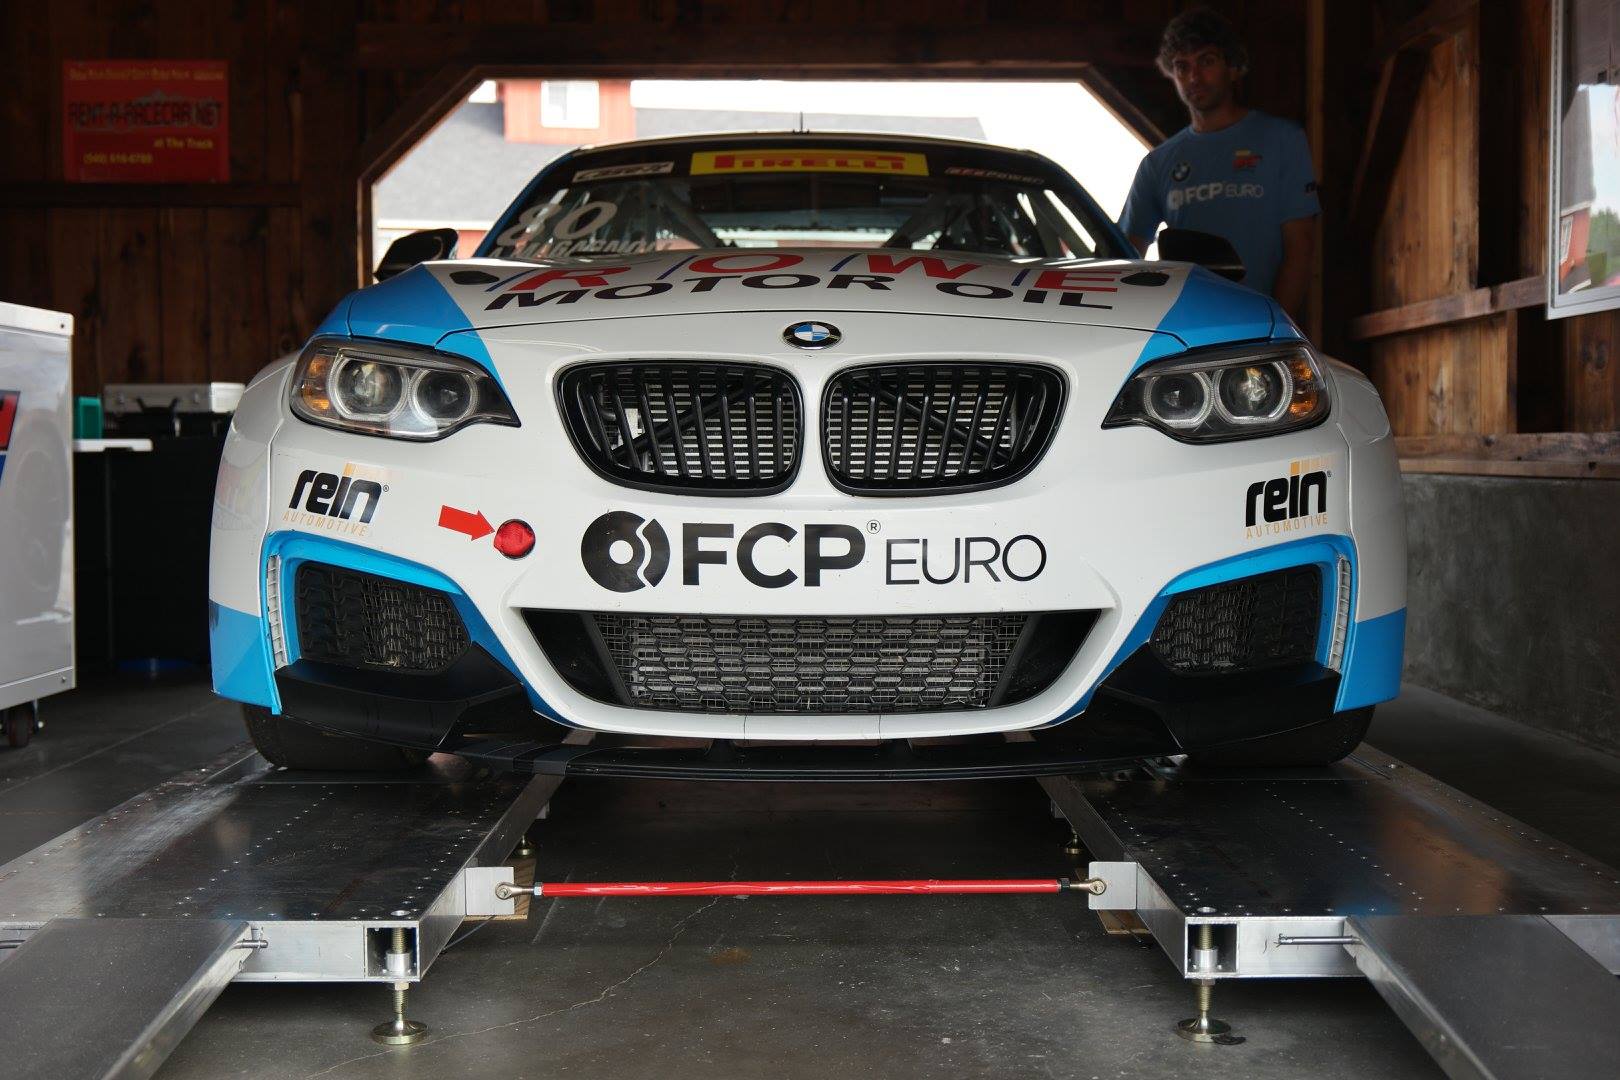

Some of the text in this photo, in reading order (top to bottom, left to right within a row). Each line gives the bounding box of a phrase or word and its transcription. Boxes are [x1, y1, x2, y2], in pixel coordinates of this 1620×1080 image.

[714, 154, 906, 170] PIRELLI
[1186, 182, 1264, 206] FCP EURO
[497, 201, 618, 247] 80
[484, 273, 1113, 311] MOTOR OIL
[288, 463, 382, 525] rein
[1245, 461, 1328, 528] rein
[282, 510, 369, 538] AUTOMOTIVE
[1246, 513, 1329, 541] AUTOMOTIVE
[682, 522, 1047, 588] FCP EURO
